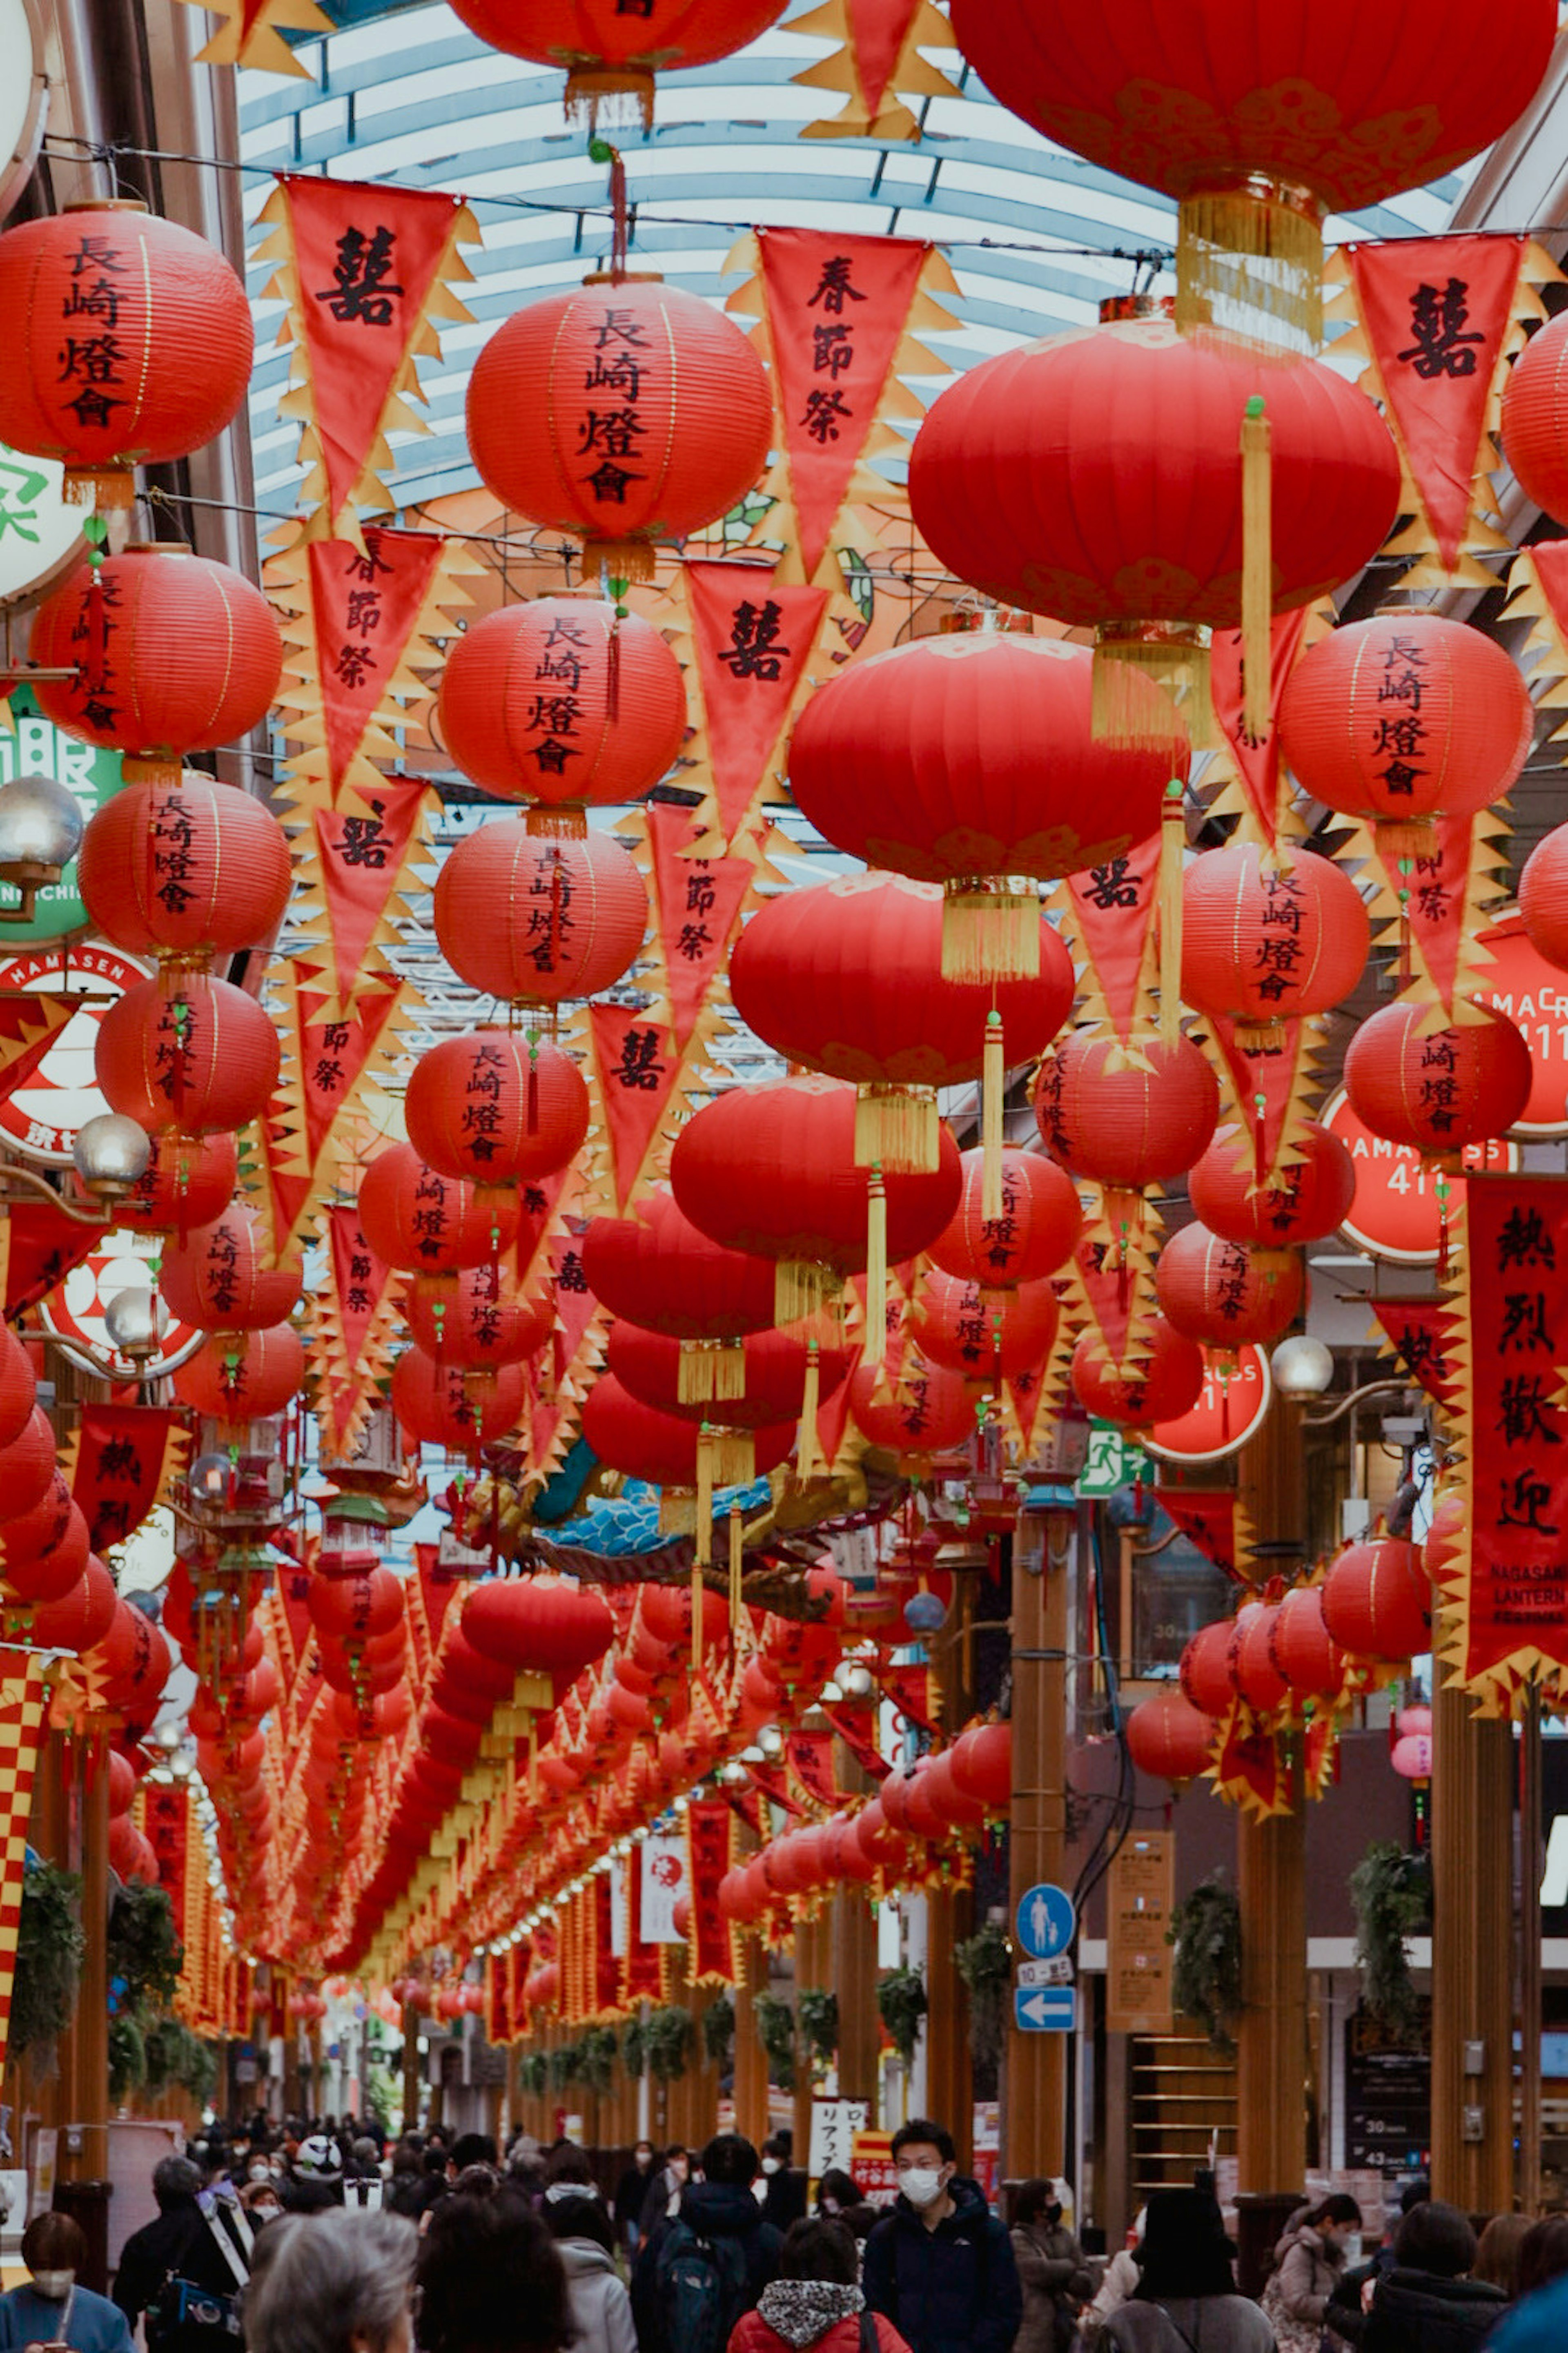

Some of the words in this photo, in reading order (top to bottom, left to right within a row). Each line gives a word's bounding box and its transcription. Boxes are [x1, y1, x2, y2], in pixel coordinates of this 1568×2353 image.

[57, 236, 129, 429] 長崎燈會
[800, 256, 867, 443] 春節祭
[576, 308, 650, 504] 長崎燈會
[523, 617, 591, 775] 長崎燈會
[1371, 635, 1431, 795] 長崎燈會
[155, 795, 199, 914] 長崎燈會
[10, 954, 125, 984] HAMASEN
[1253, 873, 1307, 1000] 長崎燈會
[462, 1045, 507, 1161] 長崎燈會
[208, 1225, 241, 1312] 長崎燈會
[1494, 1588, 1565, 1604] LANTERN
[1365, 2151, 1385, 2165] 43
